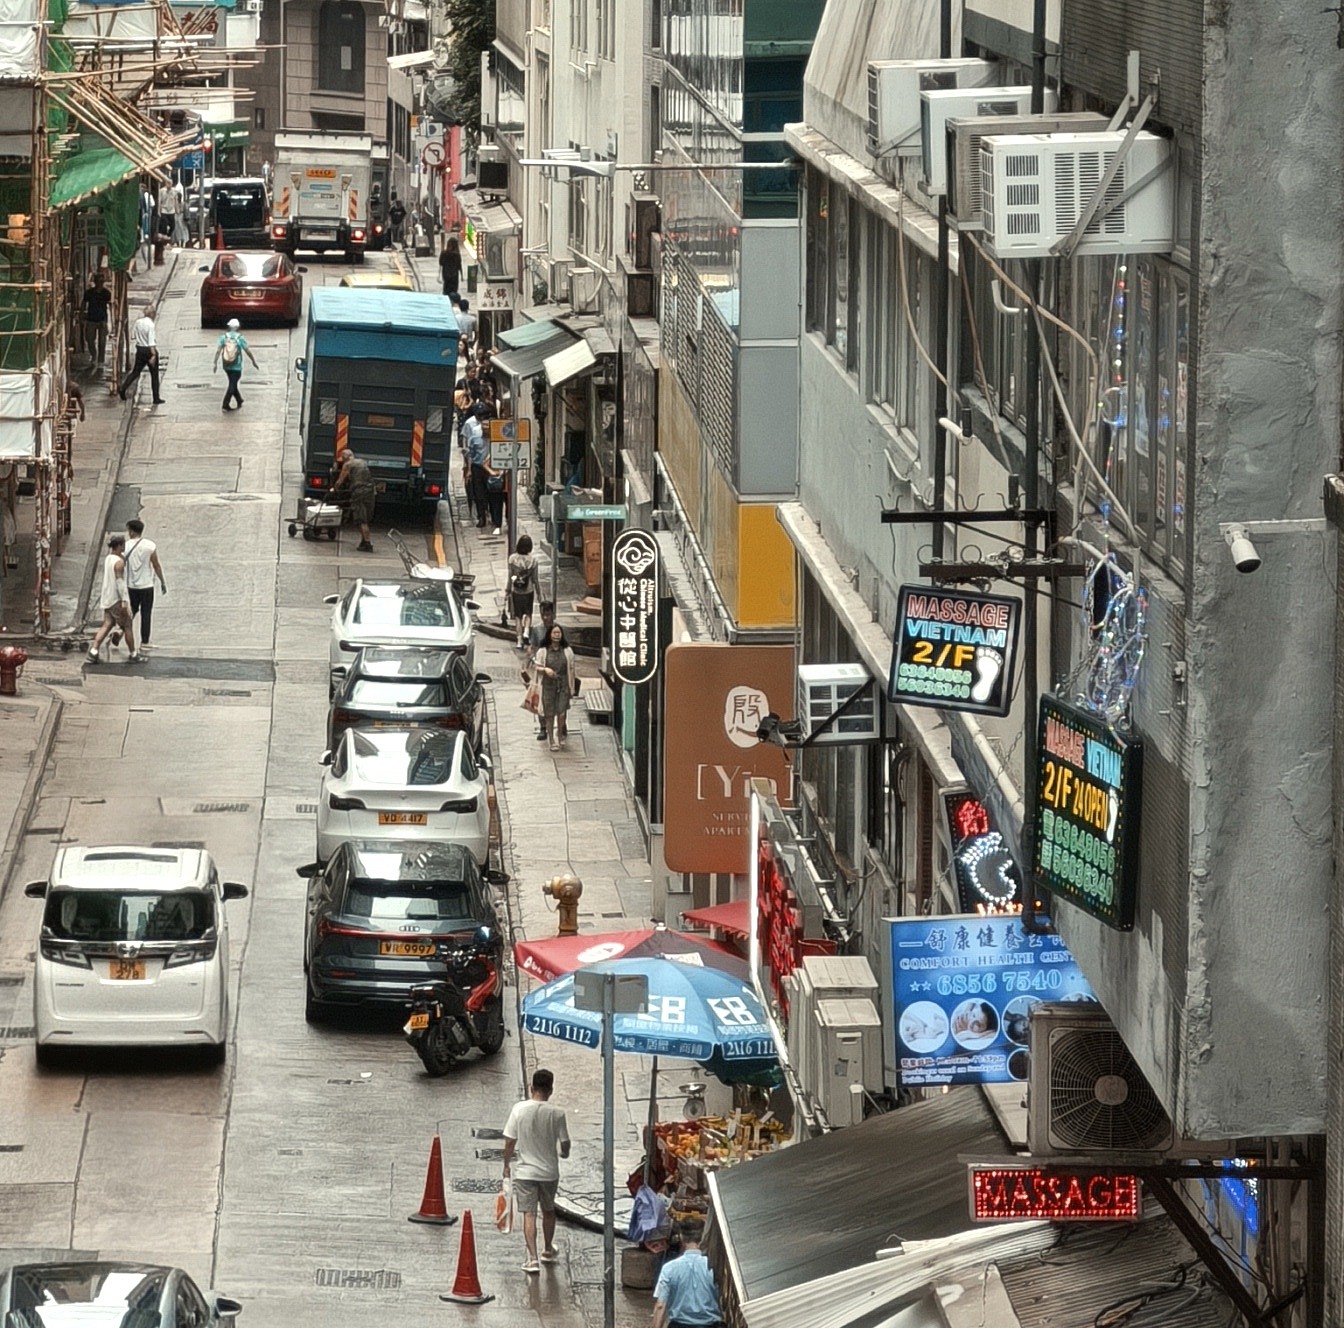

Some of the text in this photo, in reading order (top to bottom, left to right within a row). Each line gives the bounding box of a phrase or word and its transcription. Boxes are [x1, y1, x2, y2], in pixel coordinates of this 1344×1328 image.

[617, 577, 638, 667] 從心中醫館
[640, 578, 648, 667] Chinese Medical Clinic
[907, 595, 1009, 628] MASSAGE
[906, 619, 1007, 648] VIETNAM
[912, 641, 975, 667] 2/F
[1046, 716, 1121, 789] MASSAGE VIETNAM
[1043, 761, 1073, 808] 2/F
[404, 944, 432, 954] 9997
[900, 956, 970, 970] COMFORT
[977, 952, 1035, 967] HEALTH
[937, 970, 1062, 995] 6856 7540
[532, 1017, 592, 1044] 2116 1112
[984, 1176, 1132, 1210] MASSAGE
